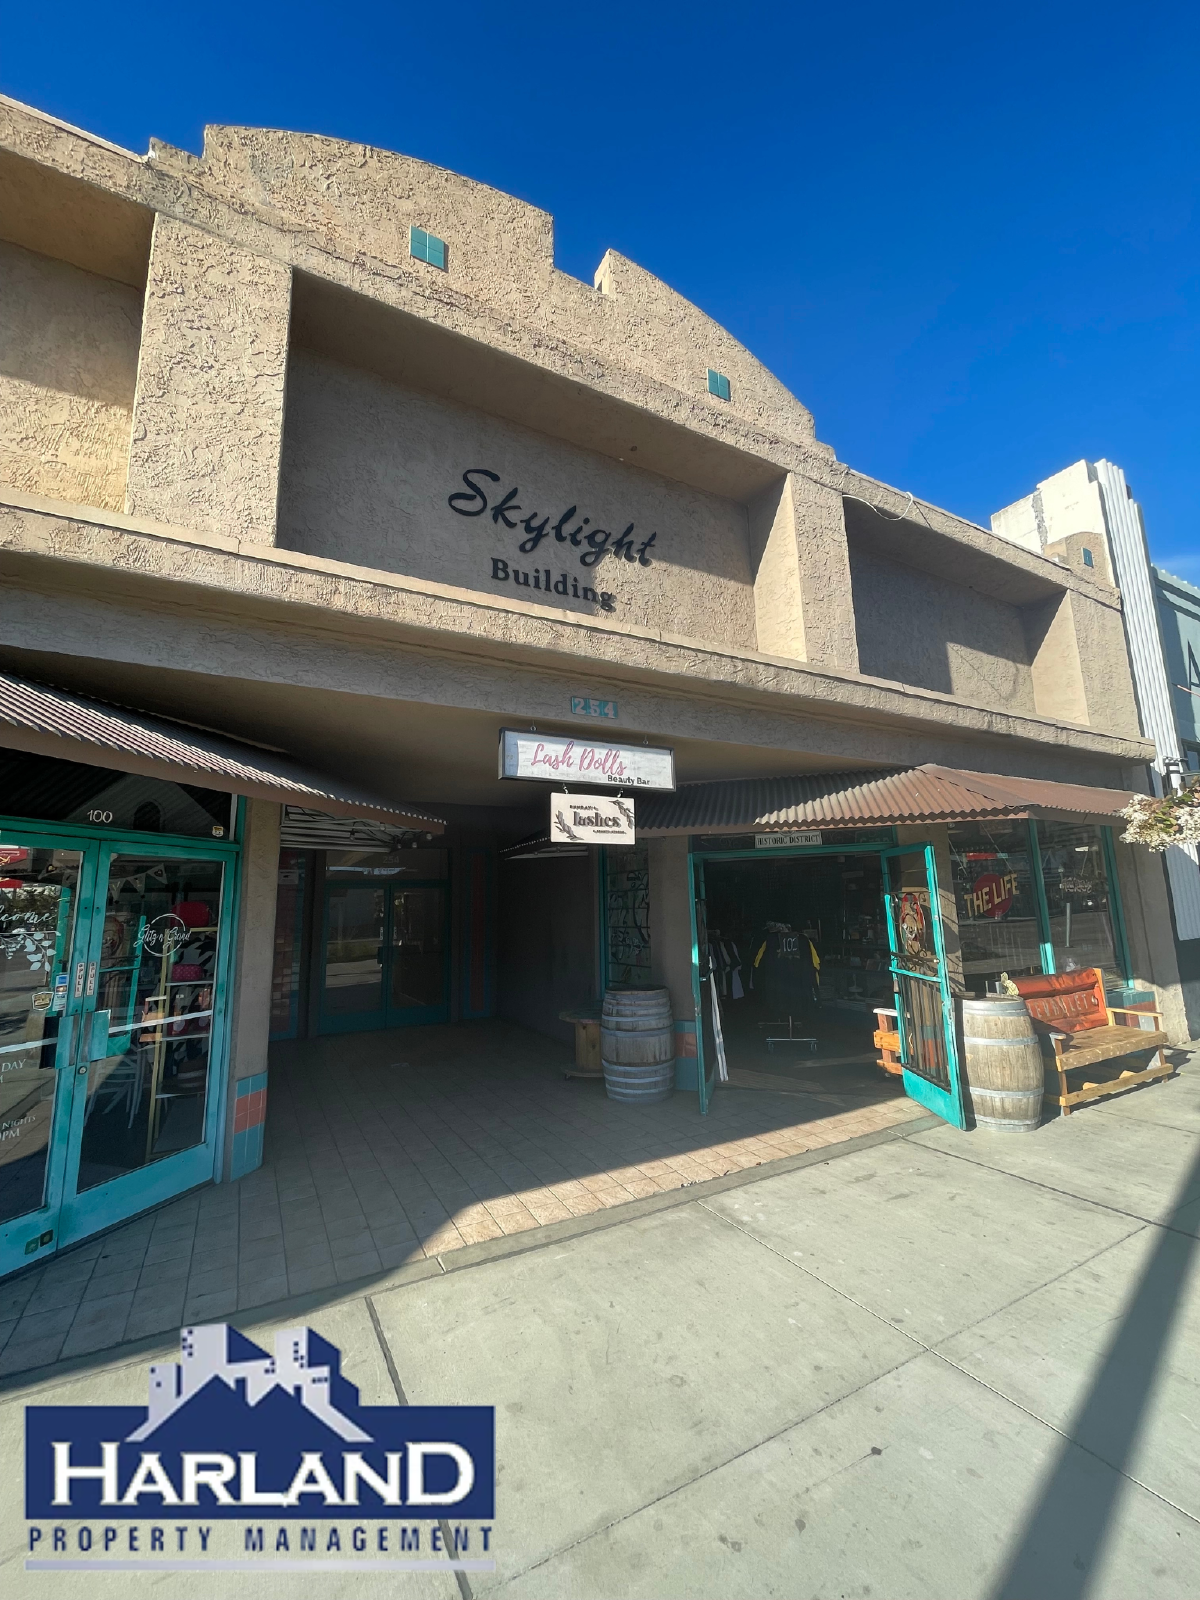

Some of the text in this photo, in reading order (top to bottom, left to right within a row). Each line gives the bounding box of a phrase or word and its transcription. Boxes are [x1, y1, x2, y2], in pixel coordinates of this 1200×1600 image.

[448, 468, 657, 568] Skylight
[490, 557, 615, 611] Building
[573, 698, 615, 718] 254
[531, 740, 627, 776] Lash Dolls
[607, 774, 651, 786] Beauty Bar
[87, 809, 113, 824] 100
[573, 811, 621, 828] lashes
[757, 834, 820, 846] HISTORIC DISTRICT
[382, 855, 400, 864] 254
[964, 873, 1020, 917] THE LIFE
[1, 1114, 37, 1131] NIGHTS
